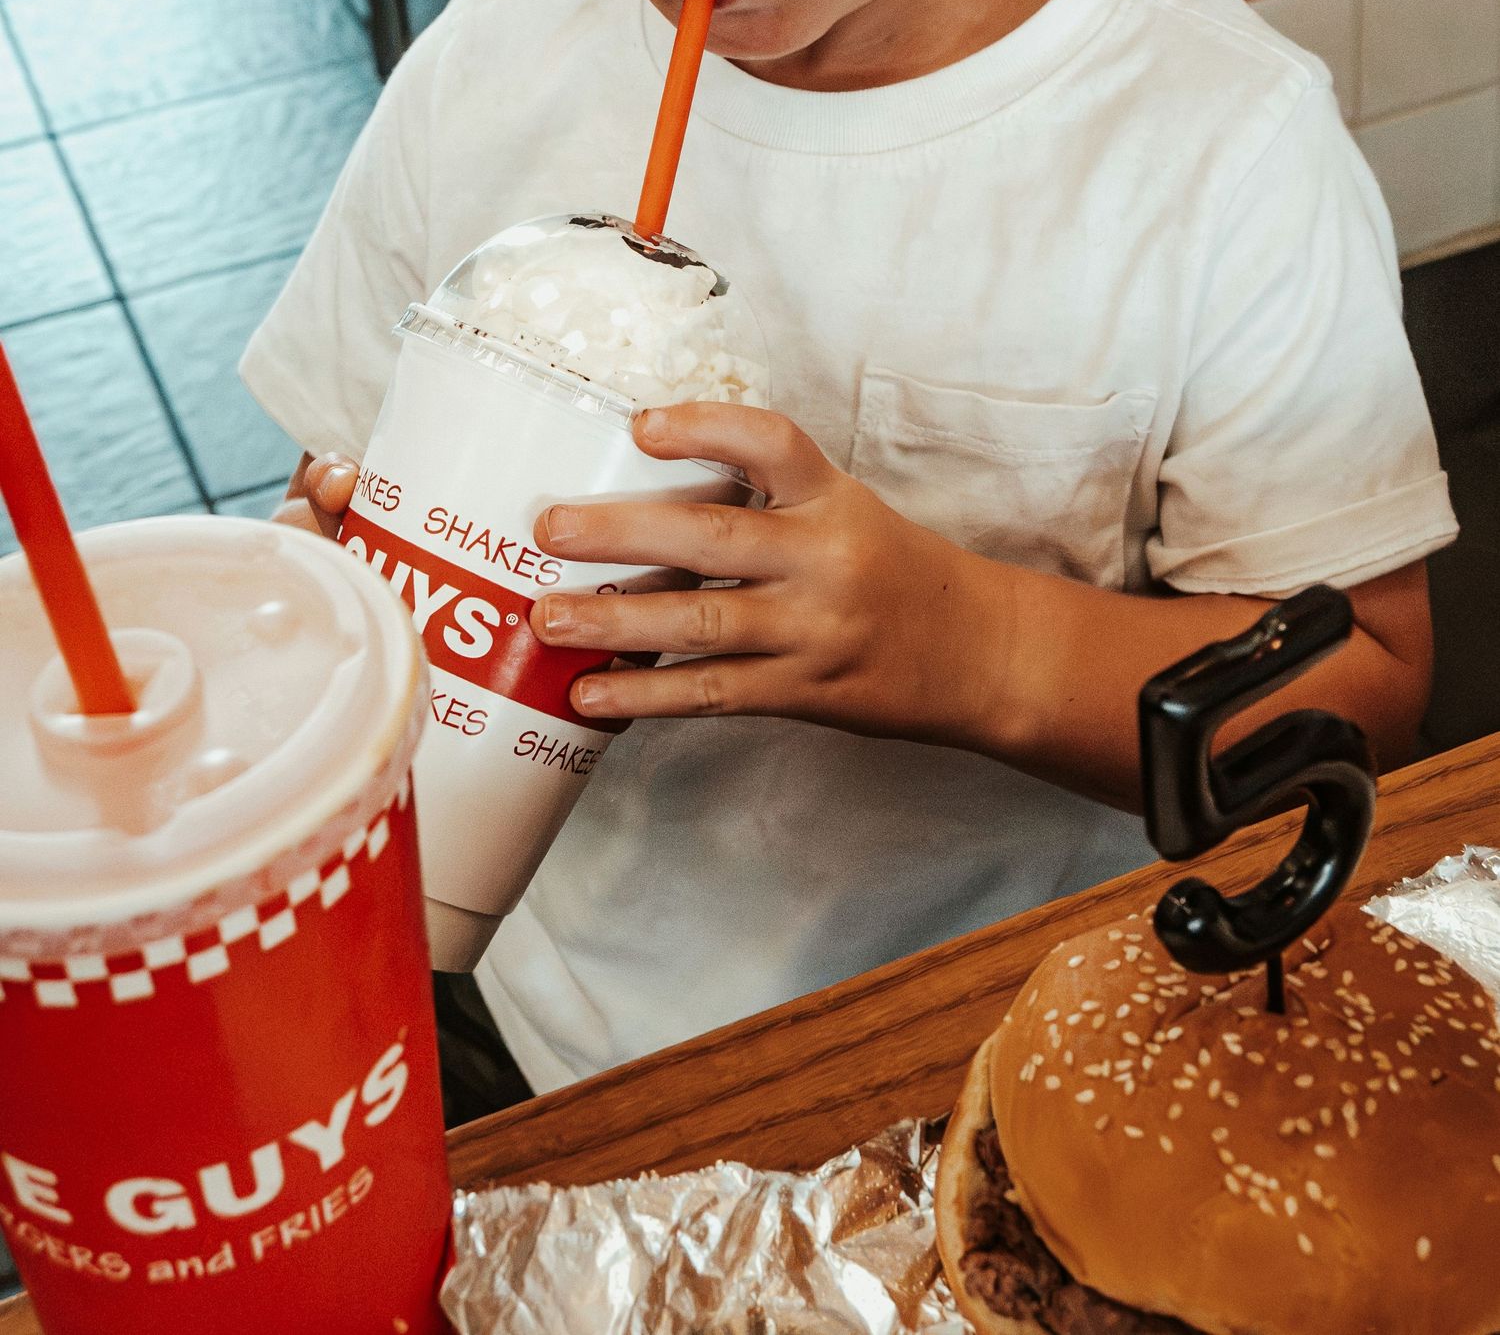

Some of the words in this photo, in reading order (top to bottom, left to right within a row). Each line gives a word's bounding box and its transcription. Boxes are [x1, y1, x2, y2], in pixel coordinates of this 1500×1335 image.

[424, 507, 563, 586] SHAKES
[430, 688, 489, 736] KES
[1138, 584, 1377, 975] 5
[104, 1043, 409, 1236] GUYS
[147, 1240, 238, 1284] and
[249, 1165, 375, 1263] FRIES
